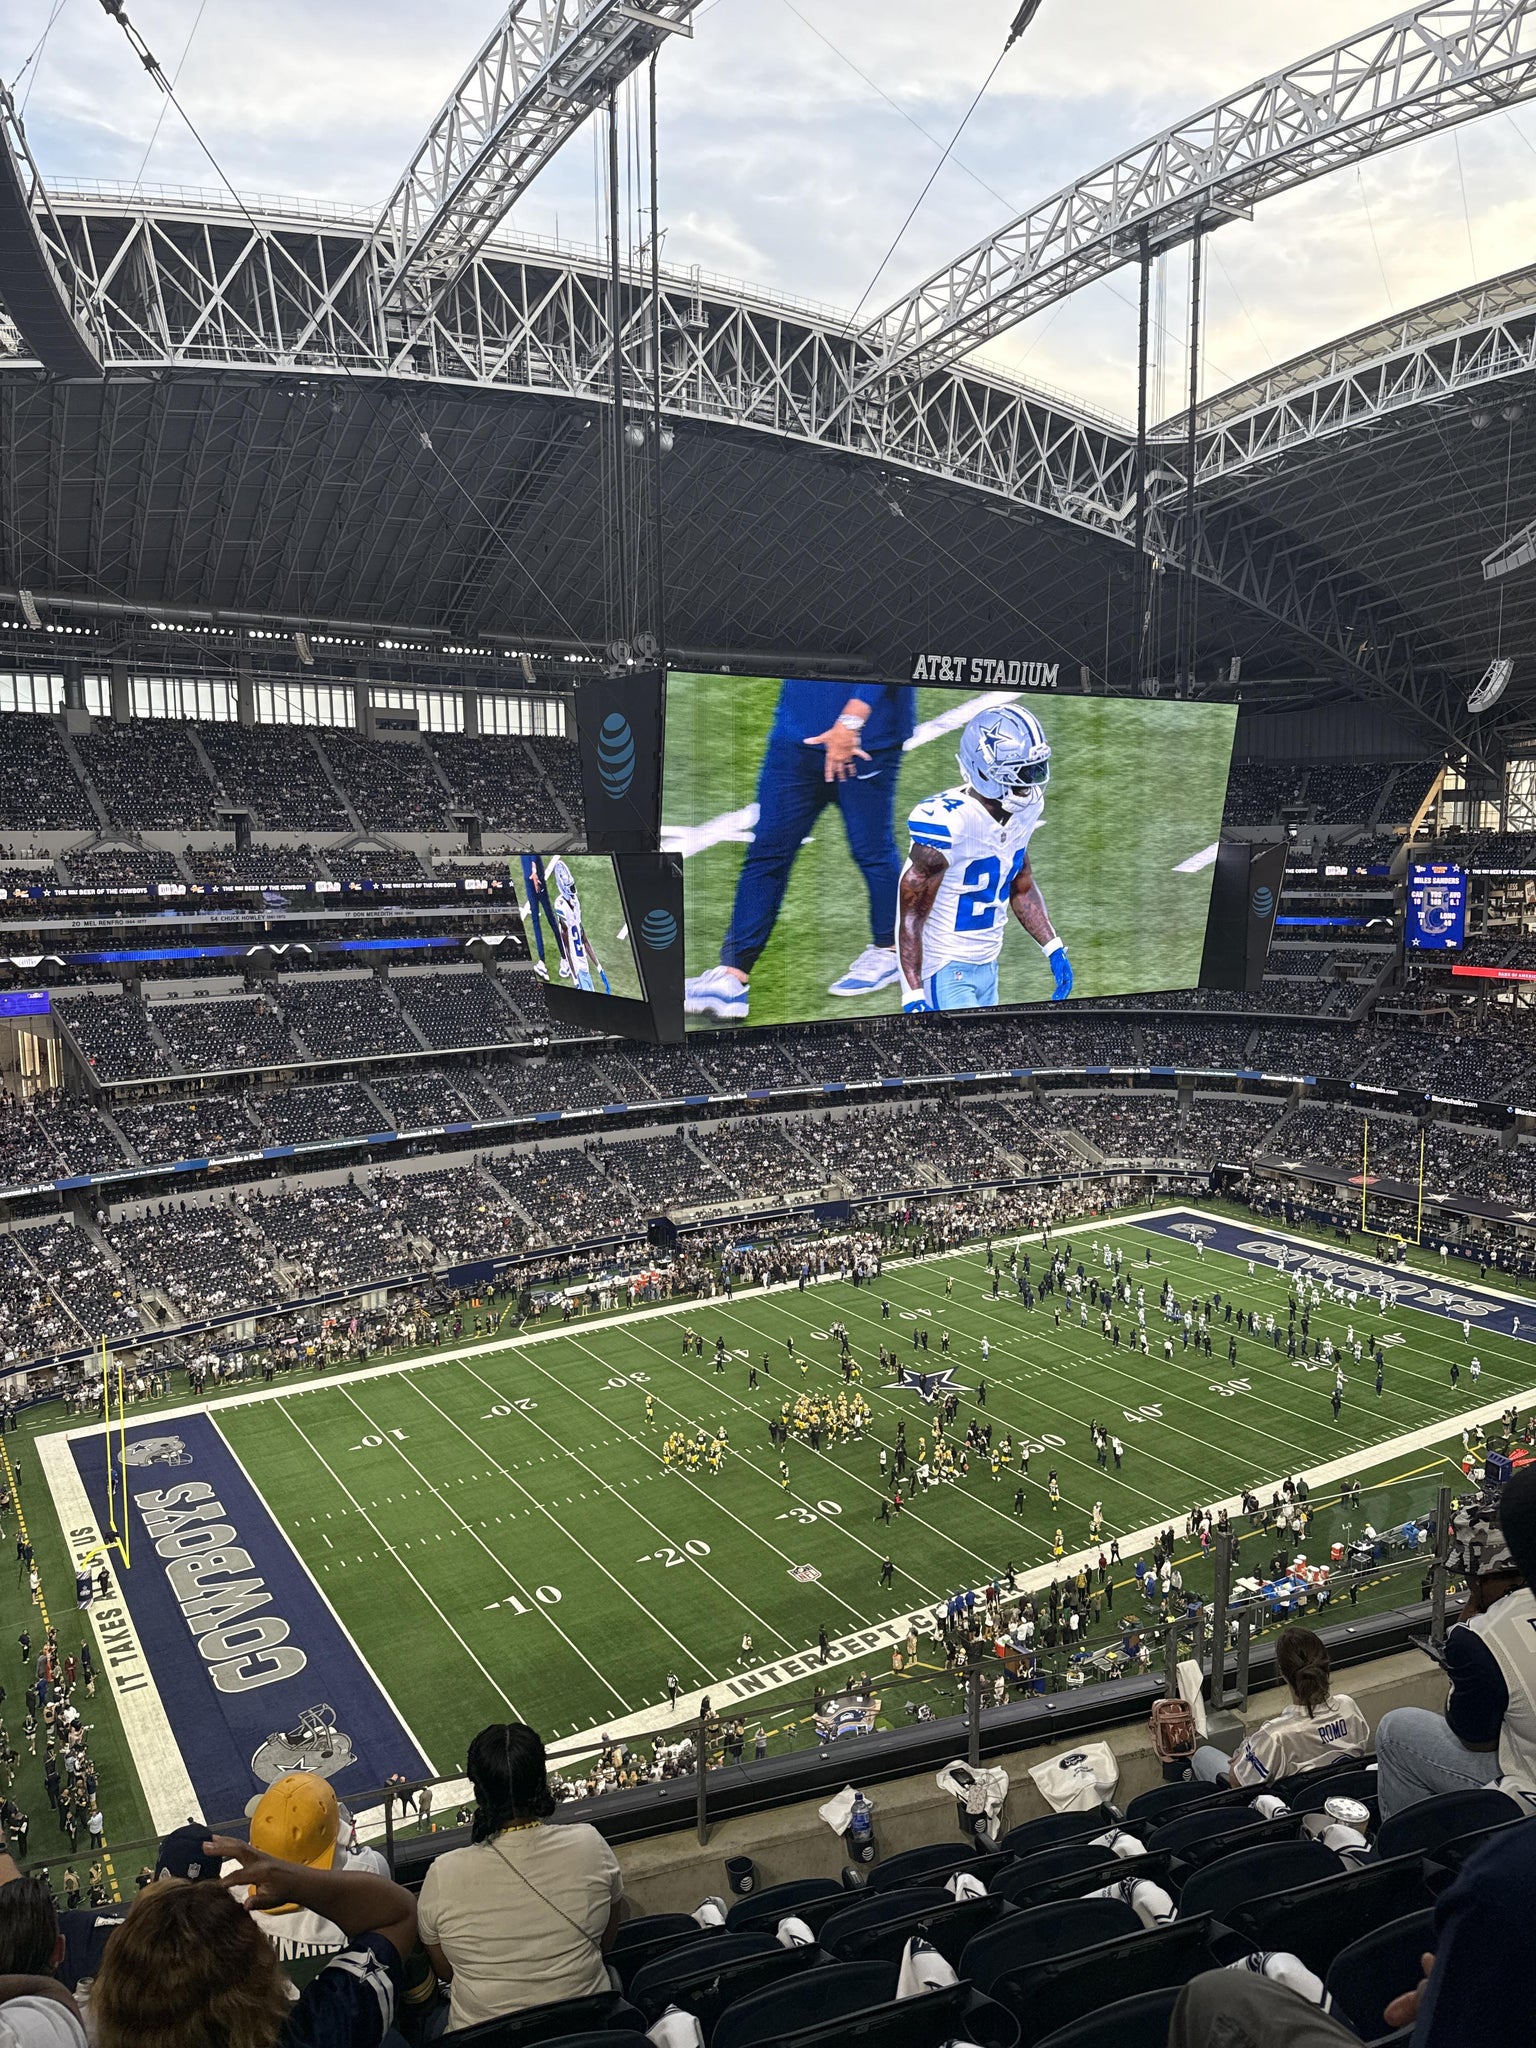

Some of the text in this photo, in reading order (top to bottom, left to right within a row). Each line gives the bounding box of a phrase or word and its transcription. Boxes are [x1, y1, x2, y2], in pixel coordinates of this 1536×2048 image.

[913, 654, 1060, 687] AT&T STADIUM
[1356, 1083, 1399, 1096] Blockchain.com
[1431, 1095, 1479, 1108] Blockchain.com
[1236, 1240, 1505, 1317] COWBOYS
[1408, 1269, 1473, 1288] CATCH
[608, 1371, 651, 1389] 30
[1208, 1380, 1252, 1398] 30
[491, 1398, 538, 1417] 20
[1122, 1405, 1164, 1424] 40
[361, 1428, 410, 1447] 10
[1018, 1433, 1067, 1454] 50
[789, 1500, 843, 1524] 30
[70, 1526, 97, 1547] US
[654, 1539, 711, 1568] 20
[134, 1481, 308, 1693] COWBOYS
[502, 1585, 563, 1615] 10
[95, 1607, 138, 1668] TAKES
[726, 1624, 902, 1698] INTERCEPT
[115, 1672, 149, 1694] IT
[1318, 1719, 1348, 1745] ROMO
